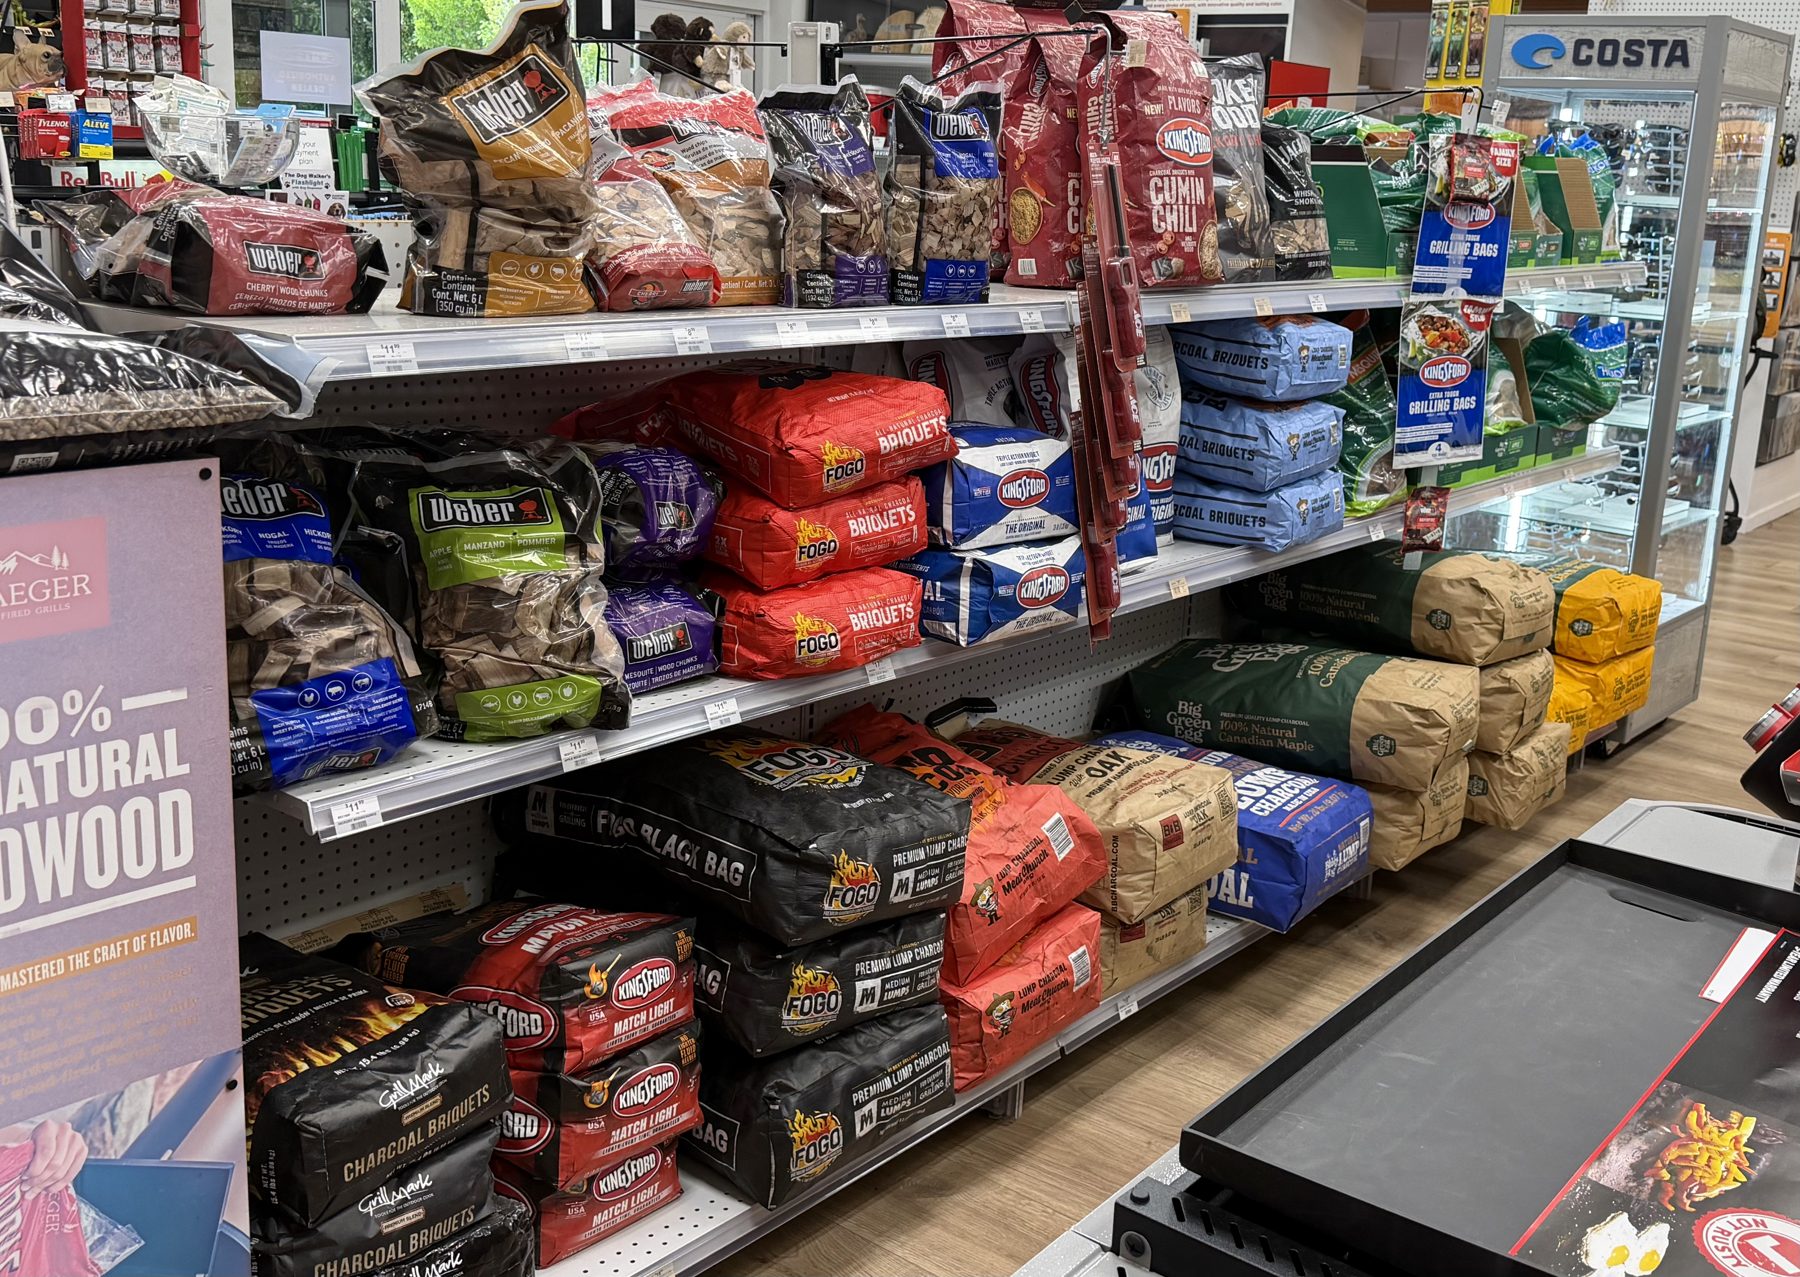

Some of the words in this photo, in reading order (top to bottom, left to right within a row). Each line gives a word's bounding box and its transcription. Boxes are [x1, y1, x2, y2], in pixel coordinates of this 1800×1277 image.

[1572, 38, 1691, 68] COSTA
[1144, 104, 1164, 116] NEW!
[1168, 95, 1200, 114] FLAVORS
[38, 118, 69, 129] TYLENOL
[83, 118, 109, 129] ALEVE
[1211, 105, 1260, 130] OOD
[1164, 127, 1211, 157] KINGSFORD
[1491, 145, 1517, 158] FAMILY
[1496, 156, 1513, 168] SIZE
[61, 171, 88, 187] Re
[101, 171, 136, 188] Bull
[291, 179, 324, 188] Flashlight
[297, 172, 308, 181] Dog
[1149, 177, 1205, 205] CUMIN
[1152, 206, 1198, 233] CHILI
[249, 245, 302, 276] weber
[1472, 243, 1499, 257] BAGS
[442, 281, 475, 293] Contient
[683, 281, 710, 293] weber
[897, 273, 918, 281] Contains
[897, 281, 918, 289] Contient
[246, 282, 275, 295] CHERRY
[279, 286, 298, 297] WOOD
[300, 287, 328, 299] CHUNKS
[432, 290, 451, 302] Cont.
[452, 291, 470, 303] Net.
[471, 293, 478, 303] 6
[478, 294, 484, 304] L
[269, 296, 296, 308] TROZOS
[297, 299, 308, 308] DE
[436, 300, 454, 314] (350
[456, 304, 466, 313] cu
[1212, 349, 1268, 370] BRIQUETS
[1424, 363, 1466, 380] KINGSFORD
[1409, 398, 1450, 415] GRILLING
[1453, 396, 1476, 411] BAGS
[1429, 390, 1443, 399] EXTRA
[1444, 390, 1459, 398] TOUGH
[1130, 395, 1140, 424] ACE
[878, 415, 948, 455] BRIQUETS
[1202, 440, 1255, 462] BRIQUETS
[1435, 443, 1442, 452] 4
[825, 457, 865, 484] FOGO
[221, 480, 288, 518] eber
[1001, 474, 1046, 506] KINGSFORD
[429, 498, 515, 525] Weber
[848, 504, 916, 538] BRIQUETS
[1209, 509, 1266, 528] BRIQUETS
[258, 530, 290, 540] NOGAL
[1005, 523, 1018, 533] THE
[1018, 519, 1046, 533] ORIGINAL
[430, 546, 453, 559] APPLE
[464, 539, 506, 552] MANZANO
[517, 536, 556, 547] POMMIER
[799, 539, 838, 562] FOGO
[1020, 568, 1066, 600] KINGSFORD
[1110, 567, 1120, 595] ACE
[1259, 582, 1294, 598] Green
[1, 608, 32, 621] FIRED
[35, 602, 71, 615] GRILLS
[1265, 597, 1287, 612] Egg
[1326, 595, 1366, 611] Natural
[848, 601, 914, 632] BRIQUETS
[1013, 619, 1026, 631] THE
[1026, 611, 1056, 628] ORIGINAL
[632, 633, 675, 660] weber
[797, 632, 839, 657] FOGO
[625, 666, 655, 680] MESQUITE
[658, 660, 675, 673] WOOD
[675, 655, 698, 668] CHUNKS
[652, 673, 673, 685] TROZOS
[673, 671, 682, 681] DE
[682, 663, 705, 679] MADERA
[1178, 701, 1203, 718] Big
[1166, 712, 1212, 731] Green
[1219, 720, 1248, 733] 100%
[1250, 725, 1297, 738] Natural
[1281, 718, 1310, 727] CHARCOAL
[1174, 726, 1204, 744] Egg
[1219, 732, 1274, 749] Canadian
[1276, 738, 1315, 753] Maple
[250, 746, 257, 756] 6
[0, 728, 191, 816] ATURAL
[741, 747, 856, 783] FOGO
[1050, 761, 1077, 786] LUMP
[1087, 750, 1132, 780] OAK
[1250, 777, 1319, 817] CHARCOAL
[0, 788, 194, 915] DWOOD
[640, 823, 701, 871] BLACK
[704, 850, 745, 887] BAG
[893, 848, 926, 867] PREMIUM
[996, 862, 1012, 884] LUMP
[1011, 835, 1045, 867] CHARCOAL
[915, 876, 939, 892] LUMPS
[917, 866, 940, 881] MEDIUM
[1110, 835, 1119, 912] BBCHARCOAL.COM
[828, 881, 880, 908] FOGO
[894, 876, 911, 897] M
[520, 914, 582, 955] MATCH
[0, 957, 65, 992] MASTERED
[69, 950, 90, 969] THE
[94, 940, 130, 965] CRAFT
[133, 935, 148, 953] OF
[150, 921, 196, 949] FLAVOR.
[855, 955, 891, 977] PREMIUM
[893, 951, 913, 968] LUMP
[619, 964, 672, 1001] KINGSFORD
[884, 976, 911, 989] MEDIUM
[1018, 982, 1038, 1001] LUMP
[1038, 962, 1069, 988] CHARCOAL
[241, 974, 353, 1030] RIQUETS
[785, 990, 840, 1017] FOGO
[860, 987, 876, 1006] M
[883, 985, 910, 1002] LUMPS
[589, 1011, 606, 1023] USA
[613, 1010, 647, 1037] MATCH
[648, 998, 675, 1022] LIGHT
[852, 1076, 892, 1107] PREMIUM
[892, 1066, 914, 1089] LUMP
[914, 1040, 951, 1074] CHARCOAL
[619, 1069, 676, 1109] KINGSFORD
[881, 1088, 912, 1108] MEDIUM
[919, 1079, 945, 1100] GRILLING
[880, 1098, 912, 1117] LUMPS
[343, 1130, 425, 1184] CHARCOAL
[428, 1082, 491, 1136] BRIQUETS
[610, 1119, 647, 1145] MATCH
[648, 1102, 678, 1129] LIGHT
[860, 1111, 875, 1133] M
[794, 1126, 842, 1167] FOGO
[598, 1153, 657, 1195] KINGSFORD
[568, 1205, 585, 1217] USA
[592, 1202, 626, 1229] MATCH
[628, 1182, 660, 1210] LIGHT
[1733, 1215, 1768, 1237] NOT
[314, 1238, 406, 1277] CHARCOAL
[409, 1205, 476, 1252] BRIQUETS
